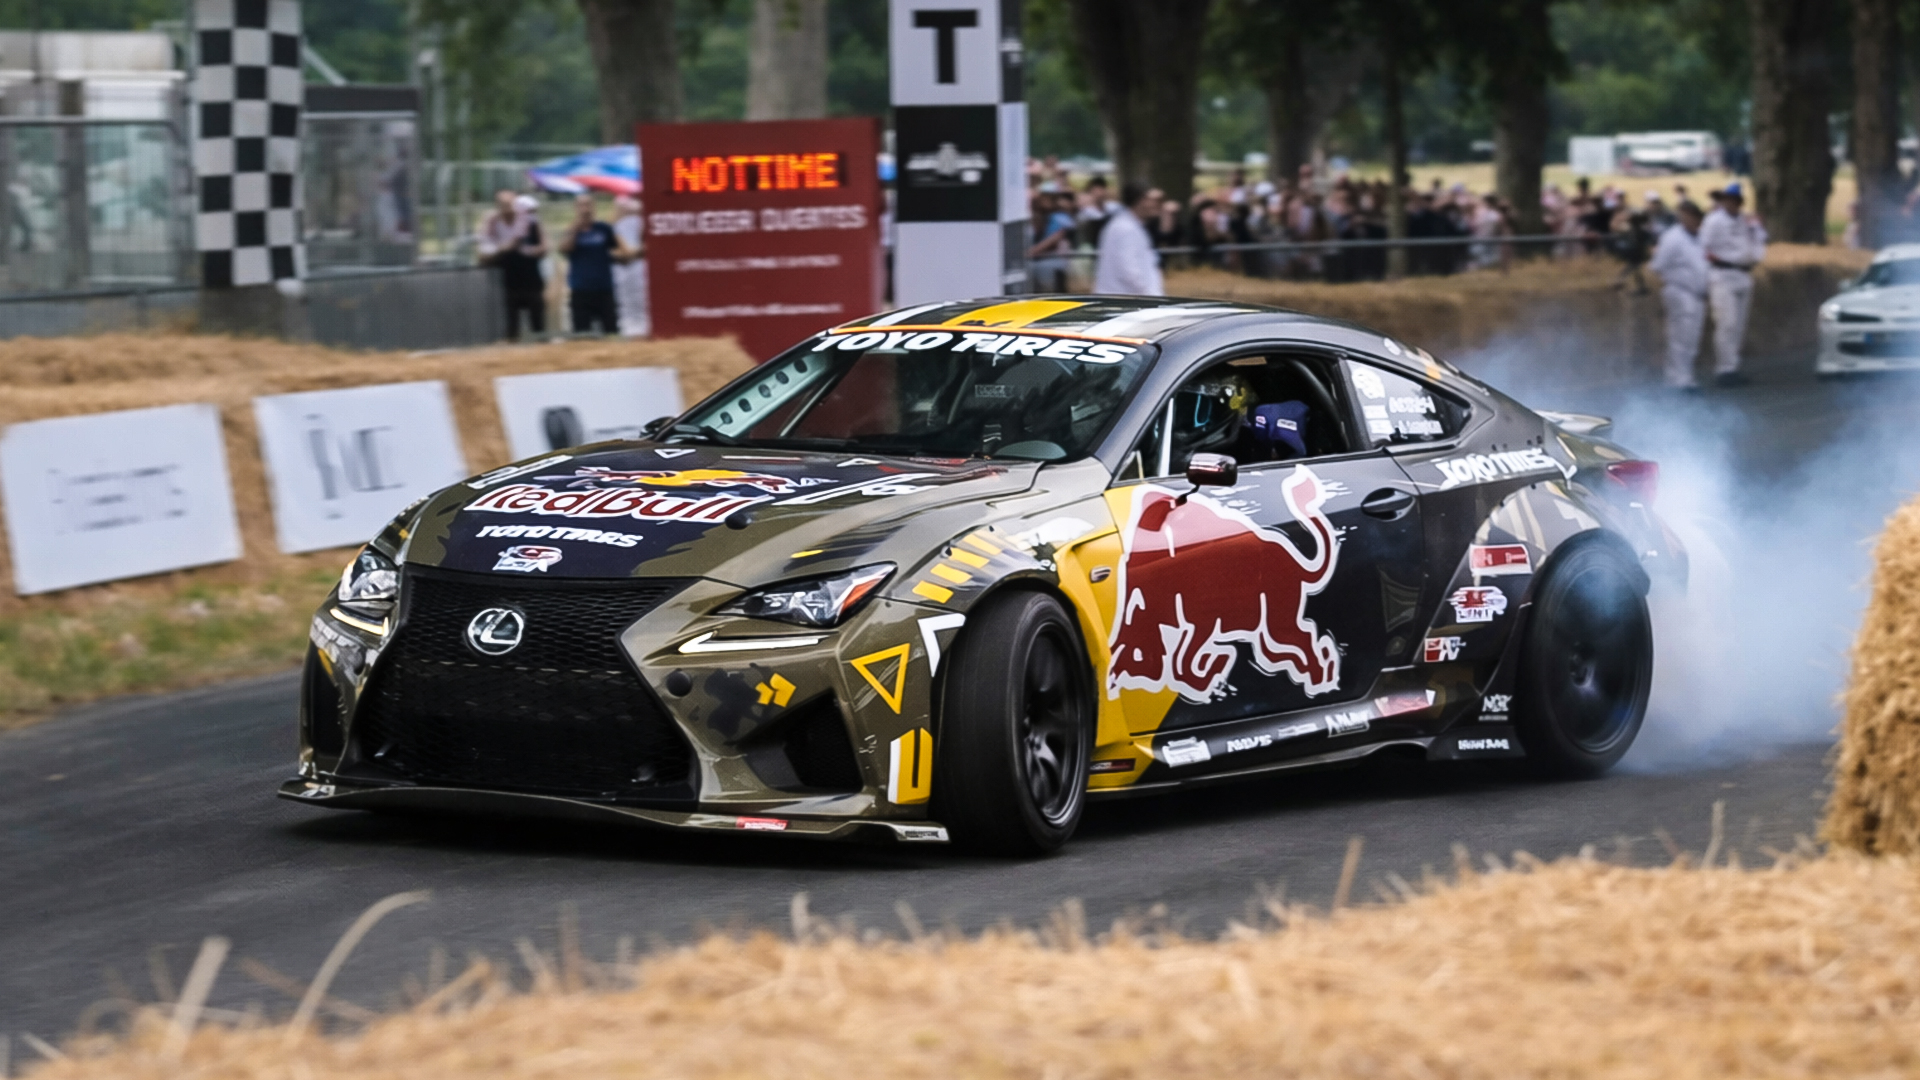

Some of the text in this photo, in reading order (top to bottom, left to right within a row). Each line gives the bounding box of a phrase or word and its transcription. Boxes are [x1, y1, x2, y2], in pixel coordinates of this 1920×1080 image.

[913, 10, 977, 84] T
[811, 331, 1137, 364] TOYO TIRES
